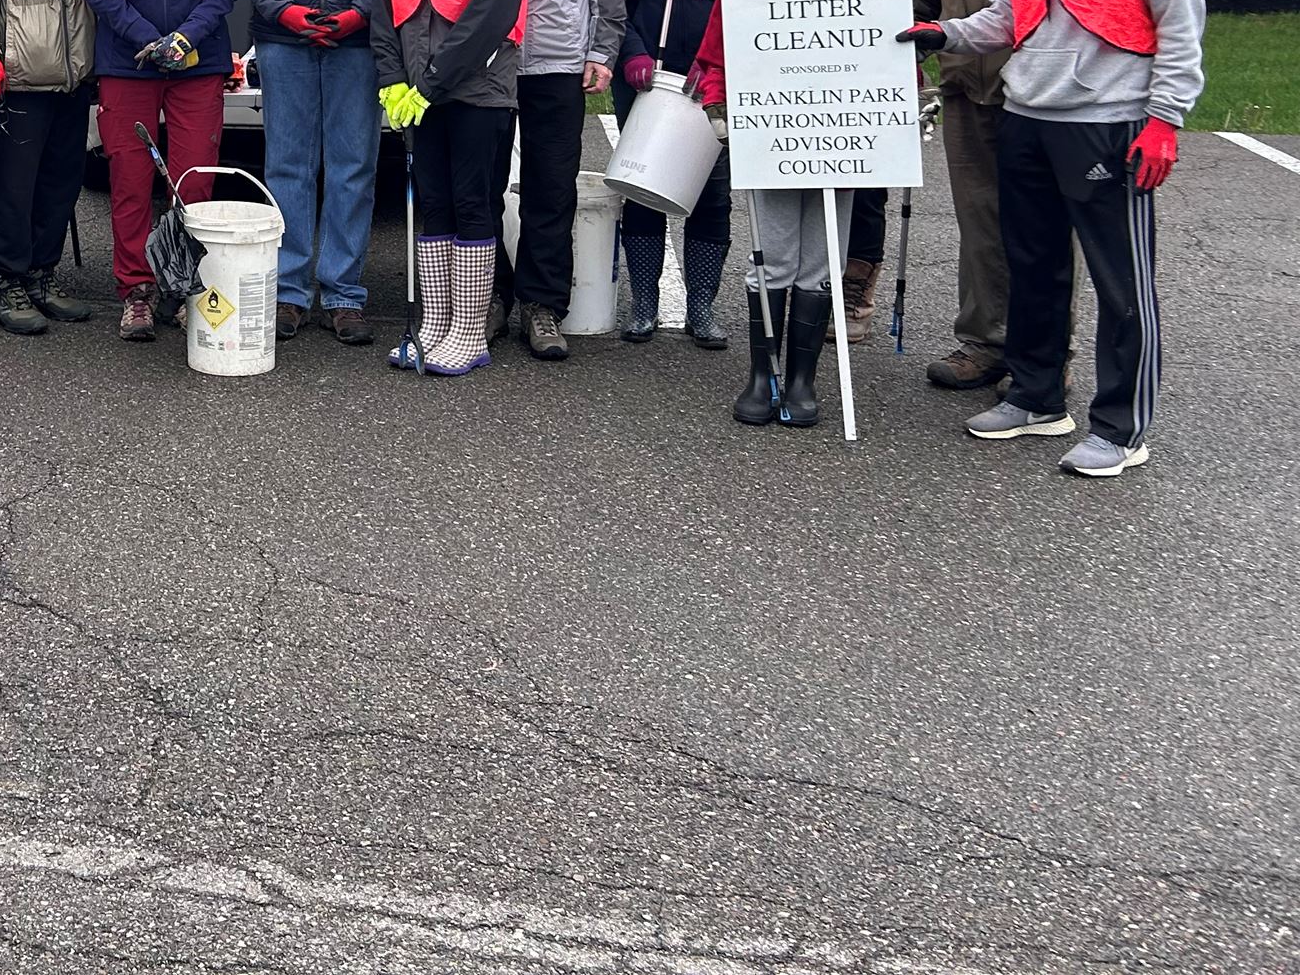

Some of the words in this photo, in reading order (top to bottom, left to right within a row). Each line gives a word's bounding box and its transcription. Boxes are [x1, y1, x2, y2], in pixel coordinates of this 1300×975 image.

[754, 28, 883, 51] CLEANUP
[780, 64, 841, 74] SPONSORED
[844, 63, 859, 72] BY
[738, 89, 843, 106] FRANKLIN
[849, 87, 906, 104] PARK
[732, 111, 915, 130] ENVIRONMENTAL
[770, 135, 878, 152] ADVISORY
[778, 159, 873, 175] COUNCIL
